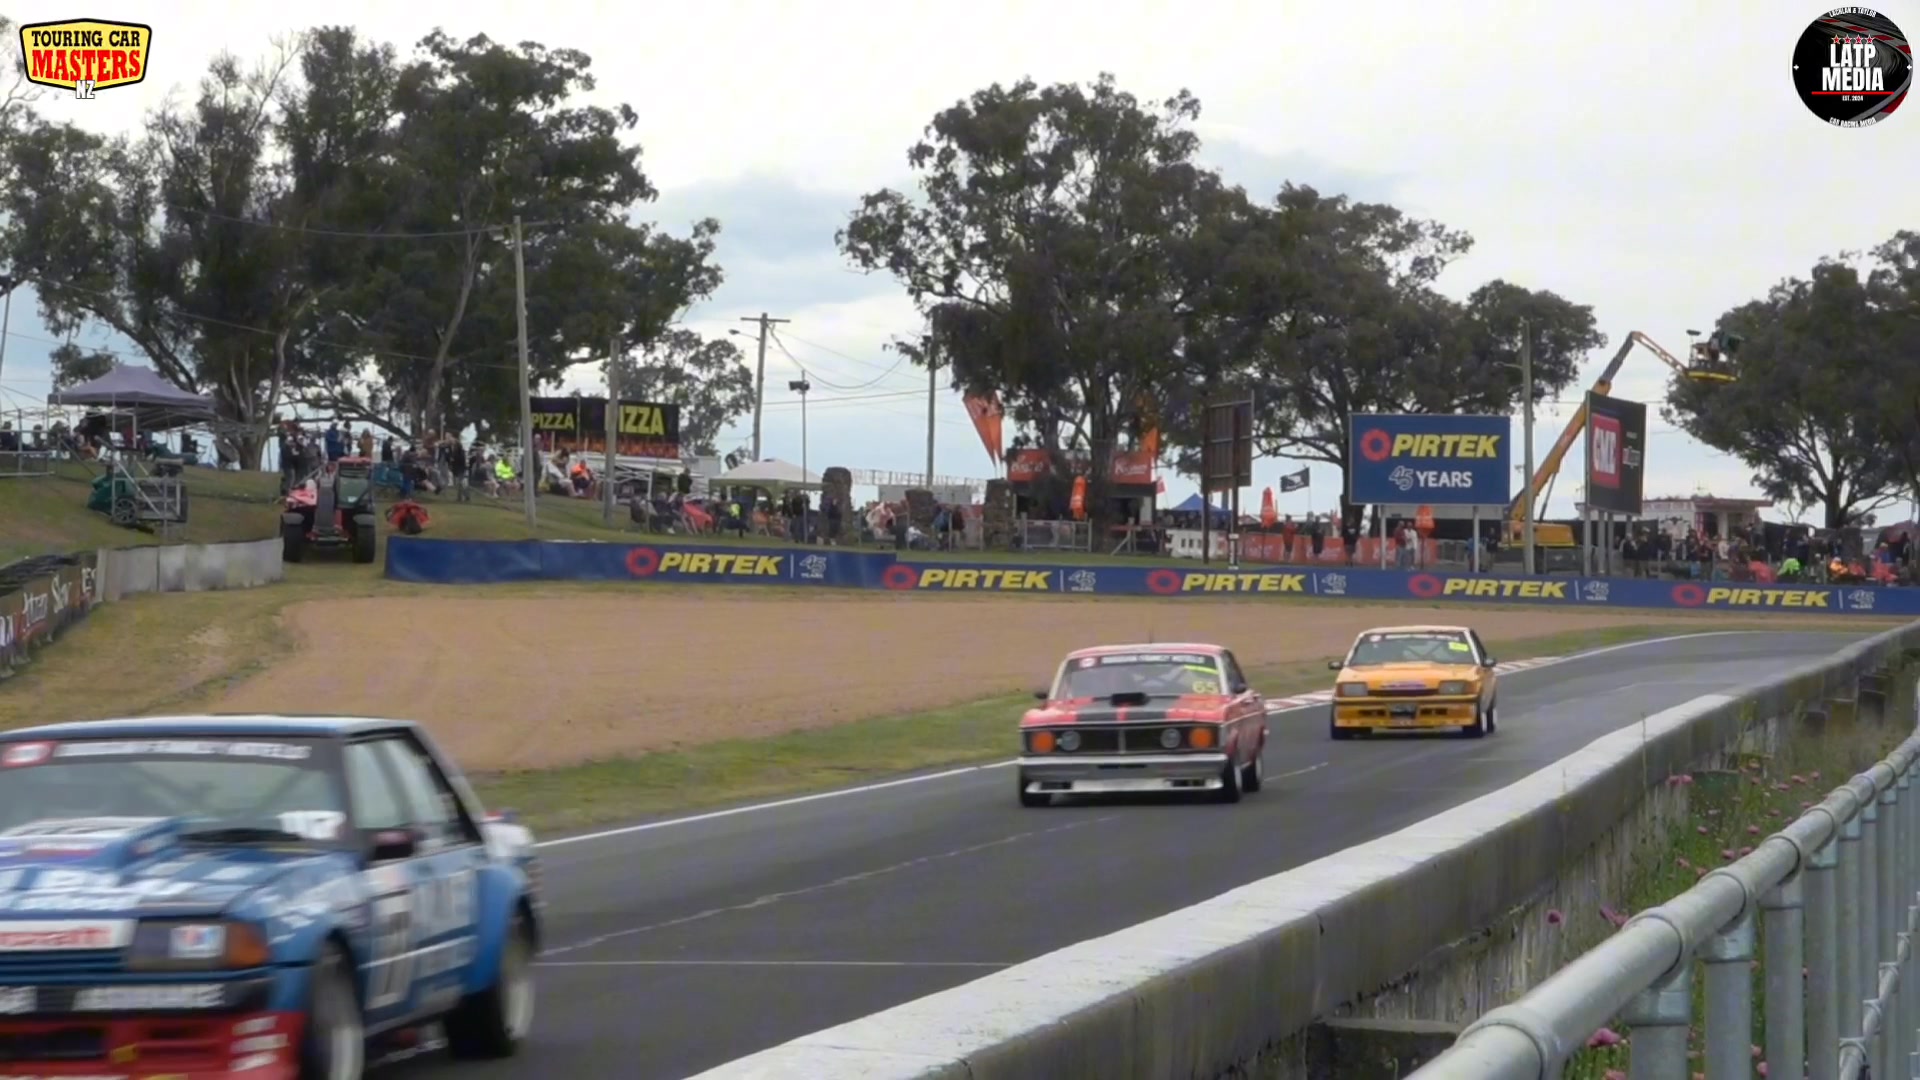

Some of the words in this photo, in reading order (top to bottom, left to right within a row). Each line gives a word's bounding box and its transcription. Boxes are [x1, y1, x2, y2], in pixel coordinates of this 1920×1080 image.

[532, 412, 575, 430] PIZZA
[1391, 434, 1500, 458] PIRTEK
[1388, 465, 1414, 491] 45
[1416, 471, 1473, 488] YEARS
[658, 552, 783, 575] PIRTEK
[918, 569, 1052, 590] PIRTEK
[1181, 573, 1306, 592] PIRTEK
[1443, 578, 1568, 598] PIRTEK
[1706, 588, 1831, 607] PIRTEK
